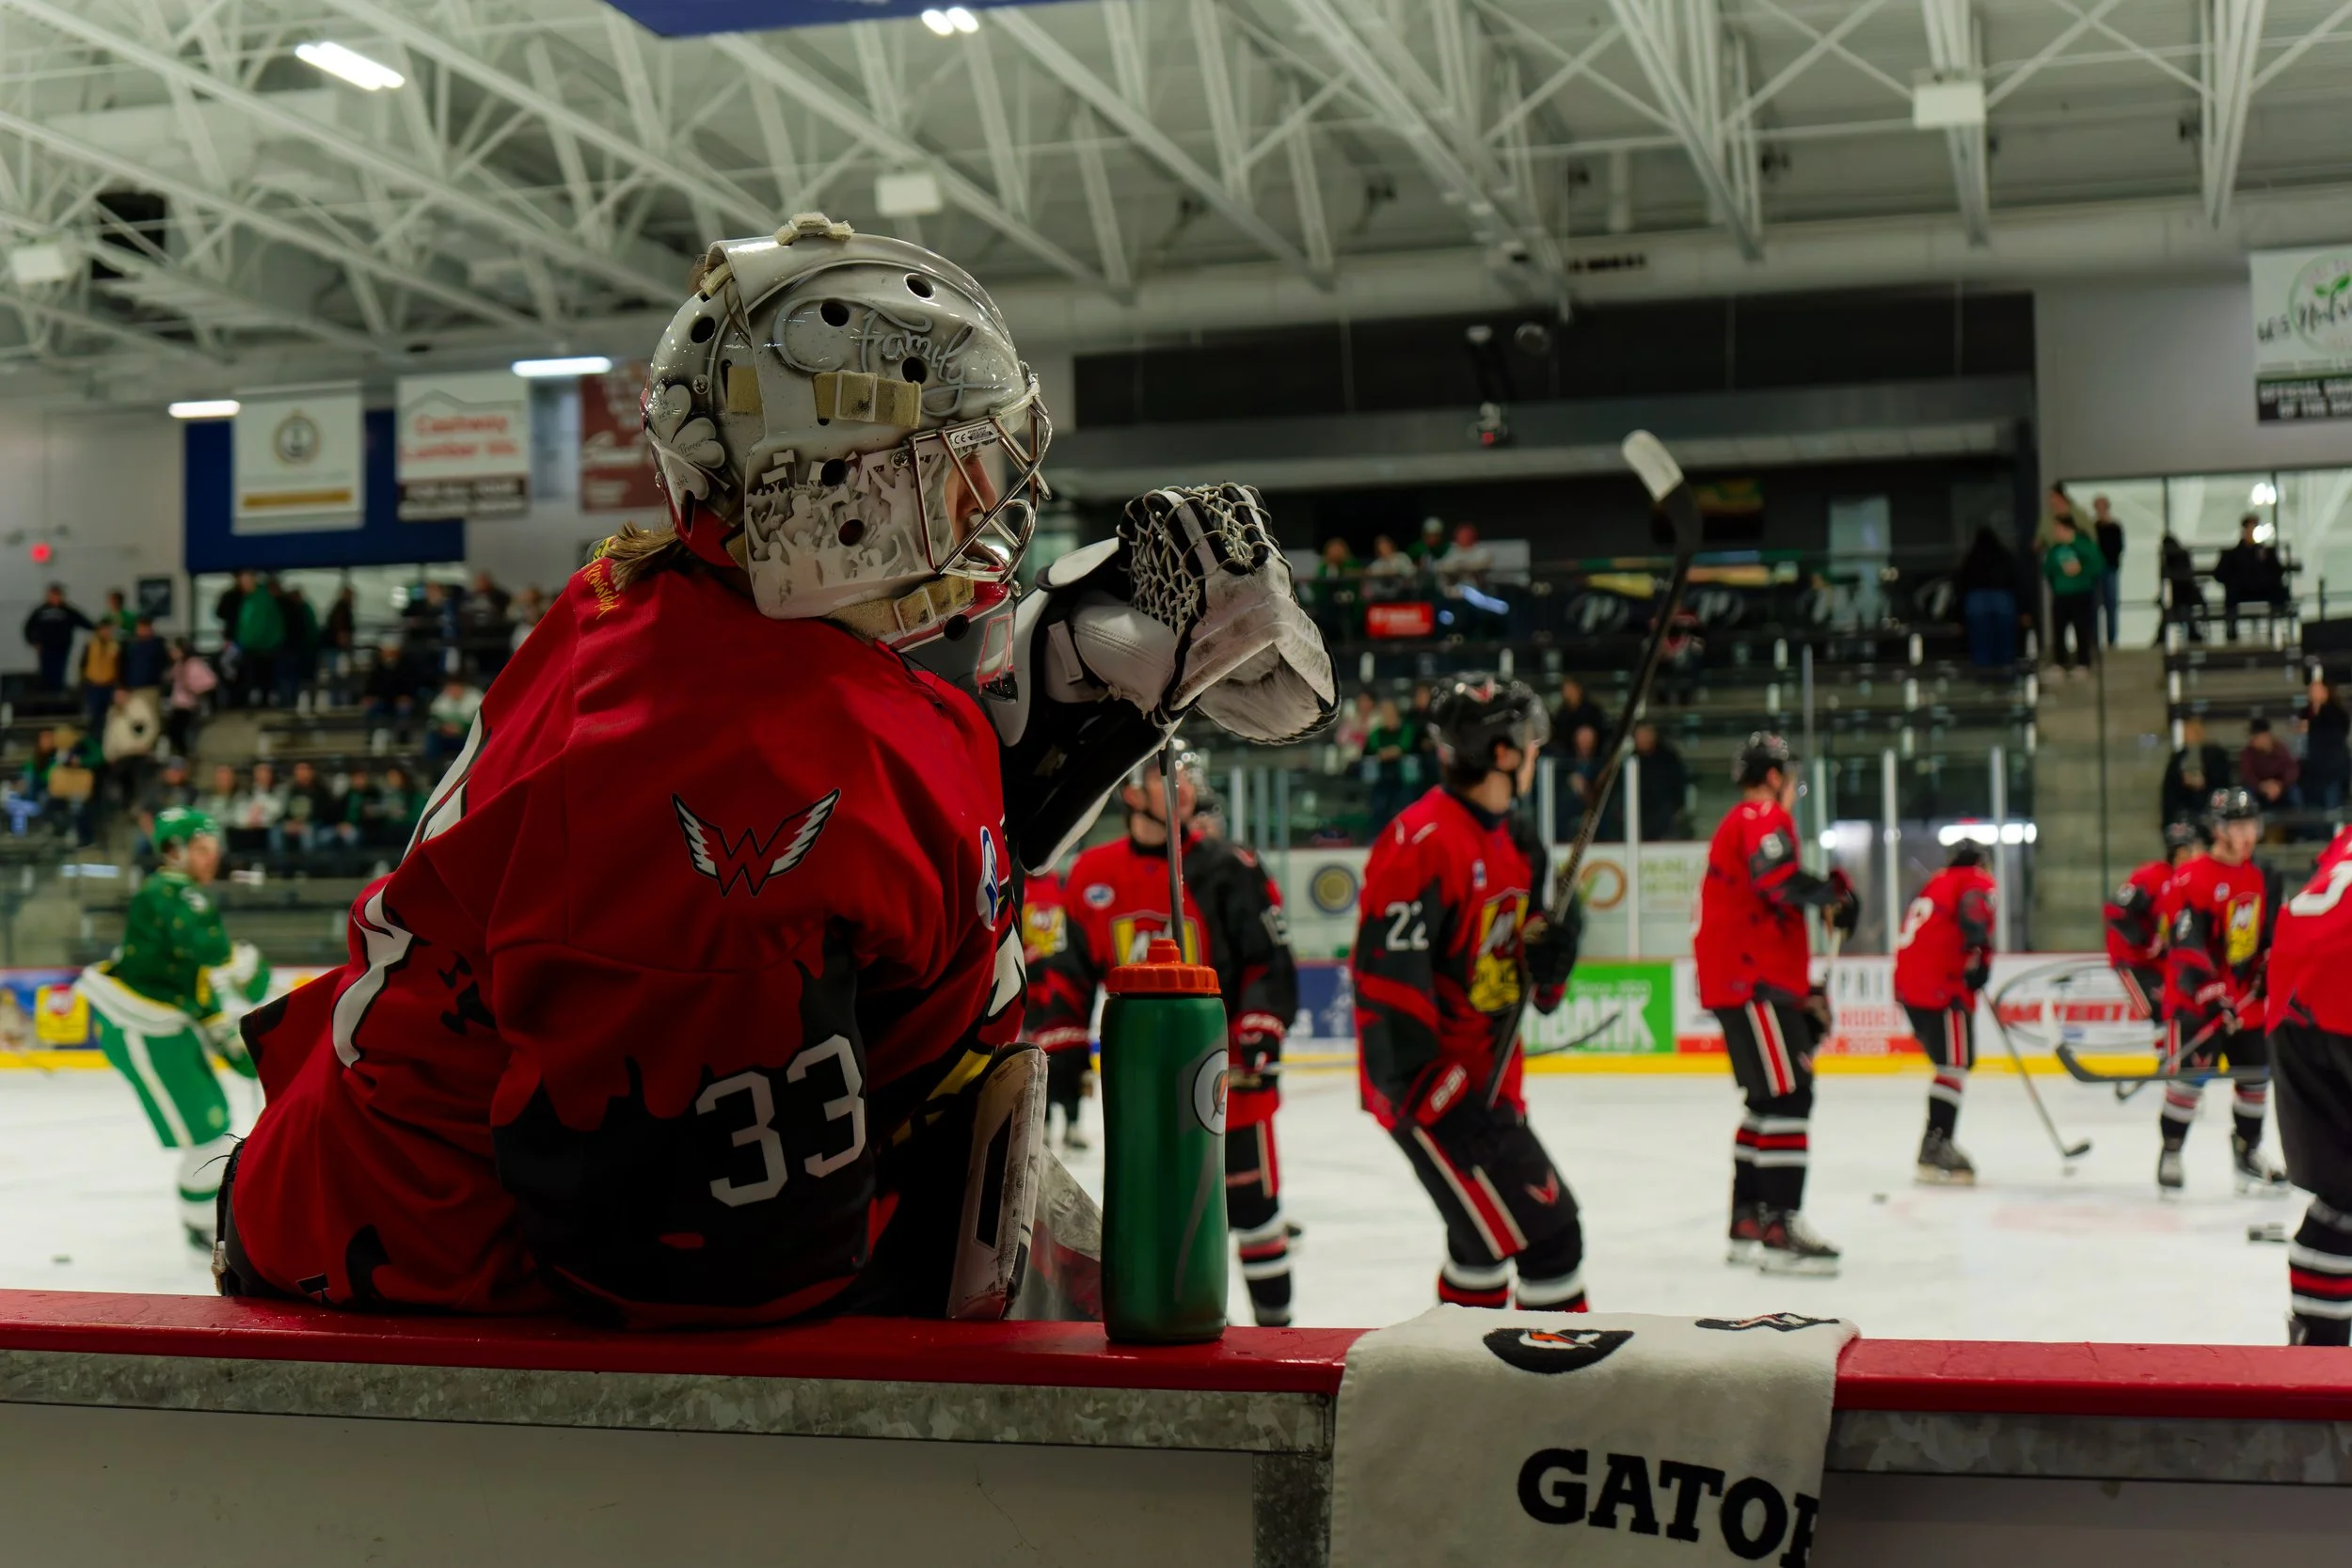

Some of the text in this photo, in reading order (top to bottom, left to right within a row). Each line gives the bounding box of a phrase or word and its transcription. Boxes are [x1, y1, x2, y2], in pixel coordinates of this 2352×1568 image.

[954, 433, 967, 445] CE
[1384, 900, 1430, 951] 22
[695, 1034, 866, 1208] 33
